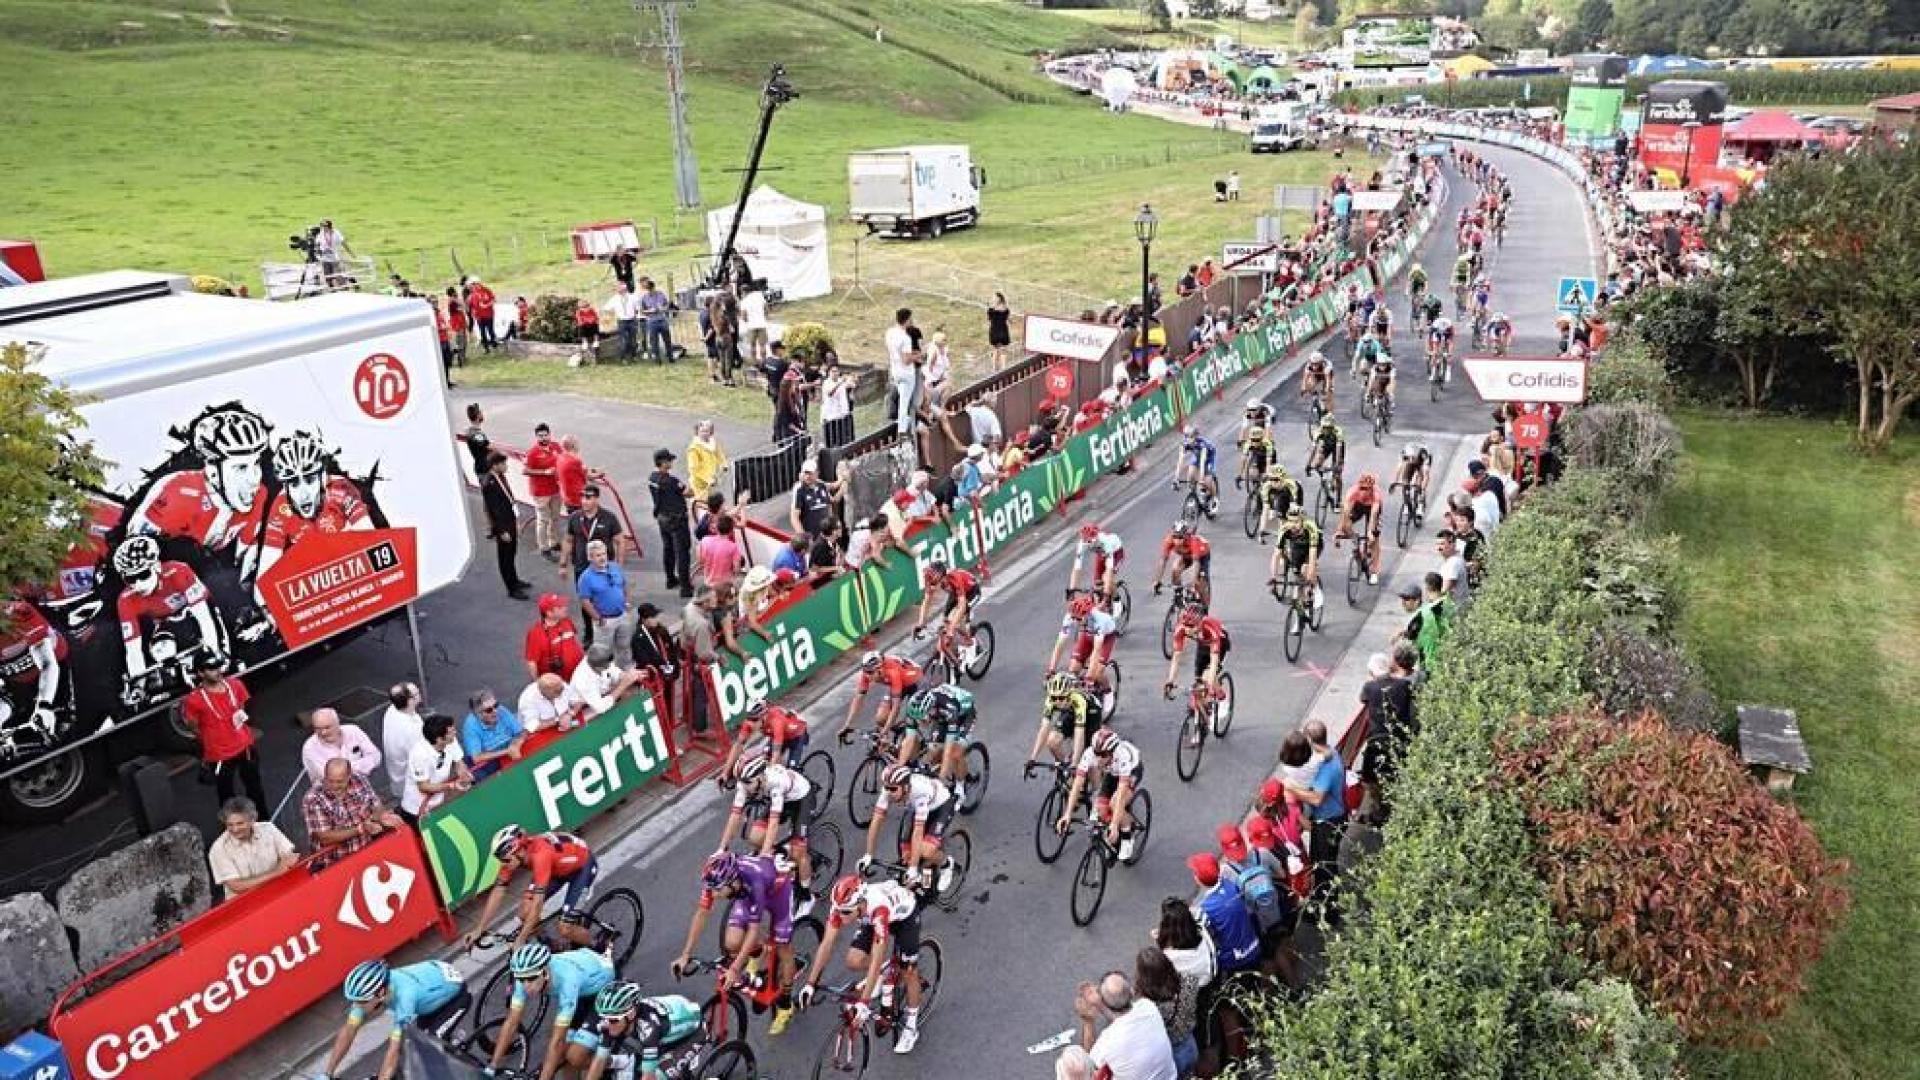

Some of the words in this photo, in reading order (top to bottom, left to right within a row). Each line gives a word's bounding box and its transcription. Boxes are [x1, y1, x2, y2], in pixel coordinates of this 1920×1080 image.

[1050, 329, 1104, 348] Cofidis
[1053, 375, 1067, 388] 75
[1508, 371, 1579, 388] Cofidis
[1089, 401, 1163, 473] Fertiberia
[1520, 424, 1539, 438] 75
[914, 485, 1035, 591] Fertiberia
[287, 580, 309, 602] LA
[309, 556, 367, 593] VUELTA
[373, 546, 391, 567] 19
[532, 697, 669, 830] Ferti
[85, 921, 322, 1080] Carrefour
